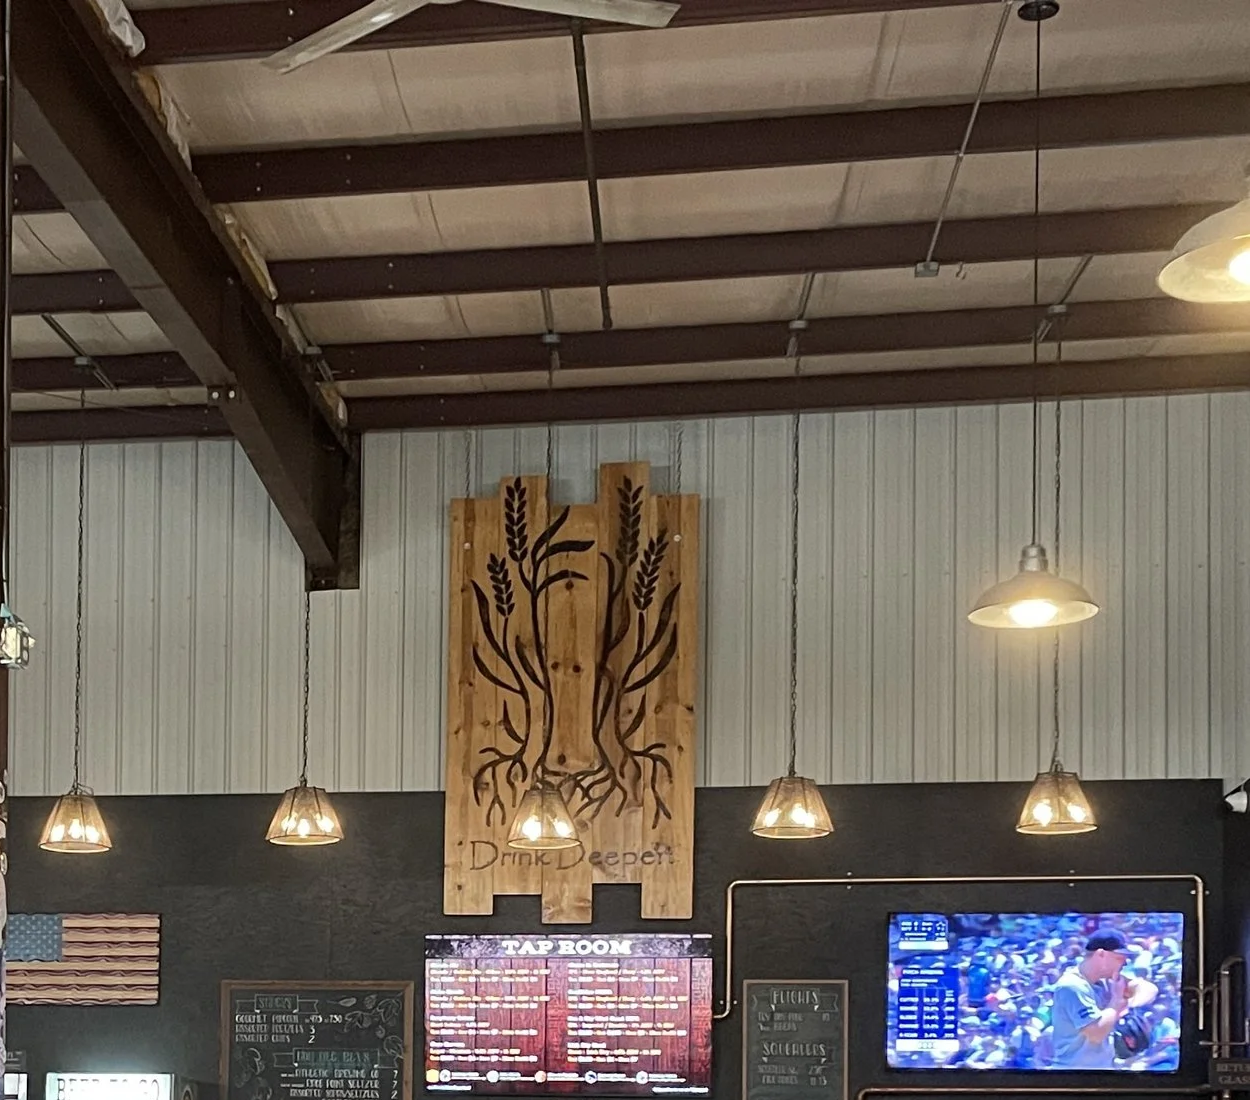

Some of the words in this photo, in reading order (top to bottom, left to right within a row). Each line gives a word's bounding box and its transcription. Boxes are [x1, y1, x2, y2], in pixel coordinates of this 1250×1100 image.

[470, 840, 550, 870] Drink
[501, 939, 554, 955] TAP
[557, 938, 633, 955] ROOM
[773, 990, 817, 1004] FLIGHTS
[308, 1034, 316, 1044] 2
[391, 1090, 398, 1099] 2
